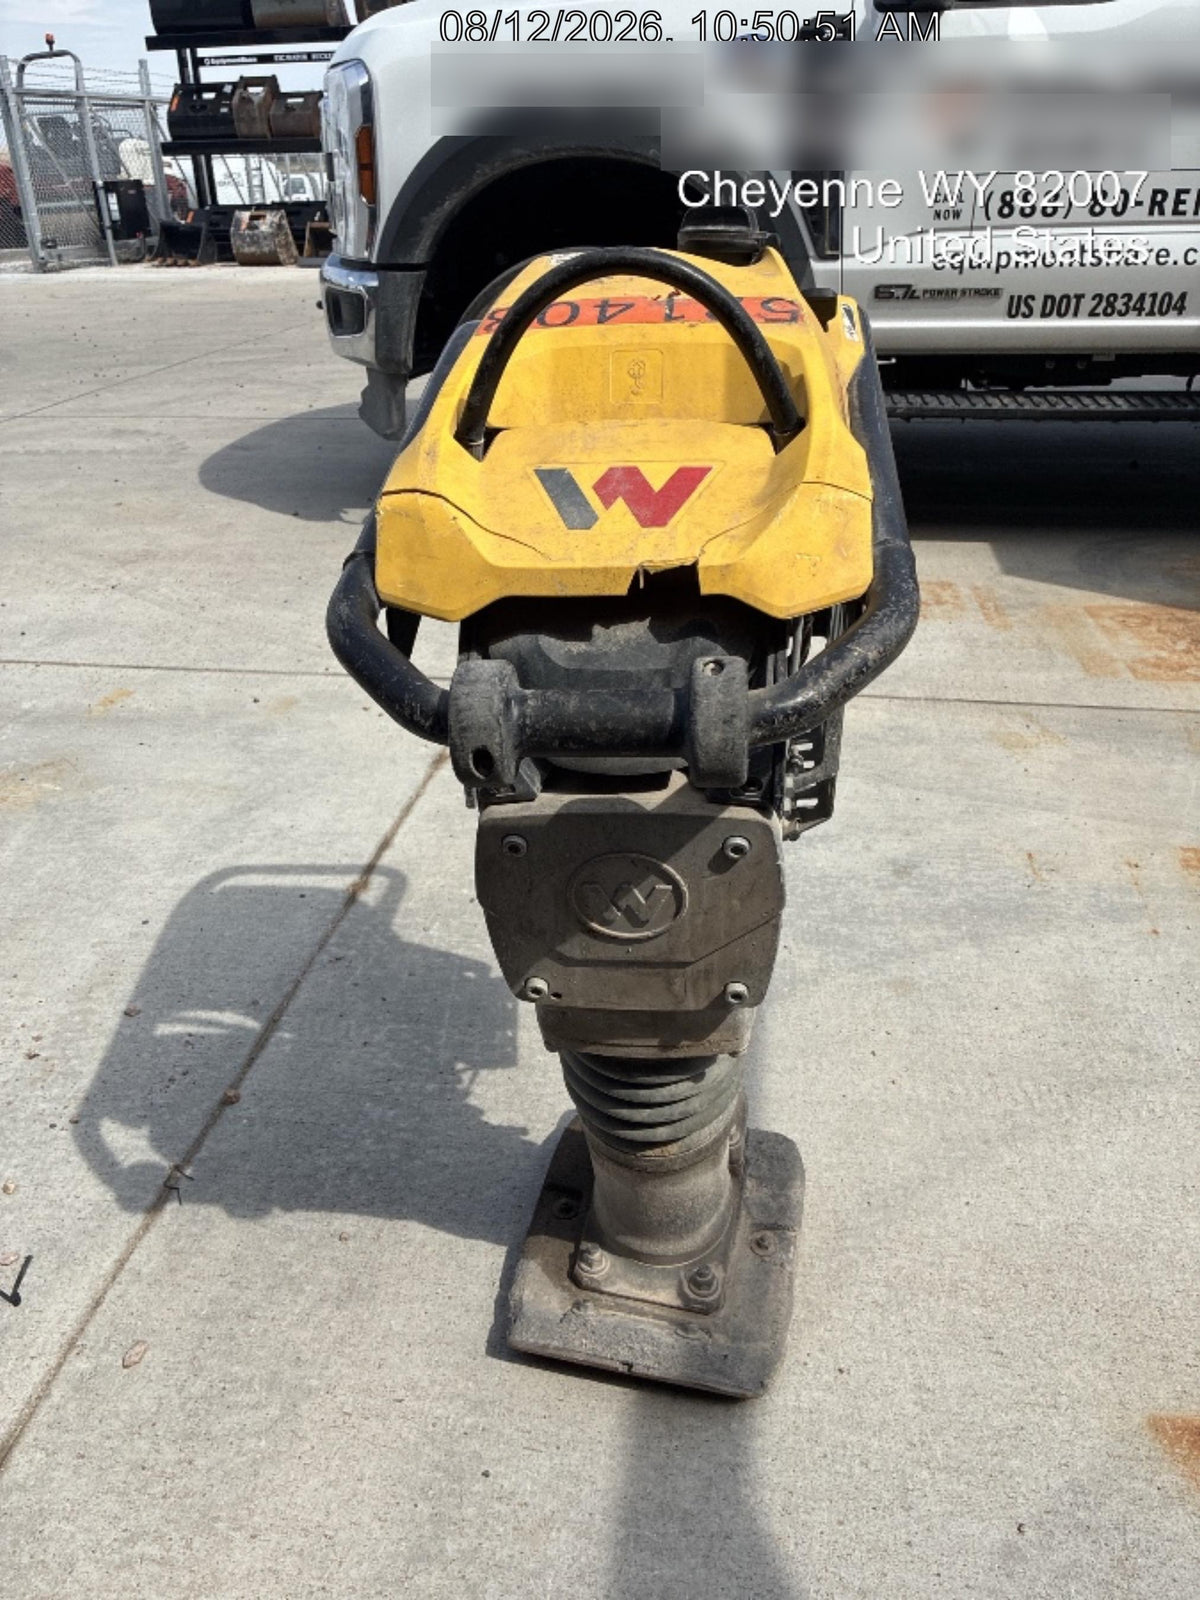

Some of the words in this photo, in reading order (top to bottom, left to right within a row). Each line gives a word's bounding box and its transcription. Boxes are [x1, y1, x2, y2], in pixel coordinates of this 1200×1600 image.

[933, 209, 963, 221] NOW
[922, 287, 958, 299] POWER
[958, 286, 1002, 298] STROKE
[1007, 294, 1034, 319] US
[1040, 293, 1084, 318] DOT
[1087, 290, 1189, 317] 2834104
